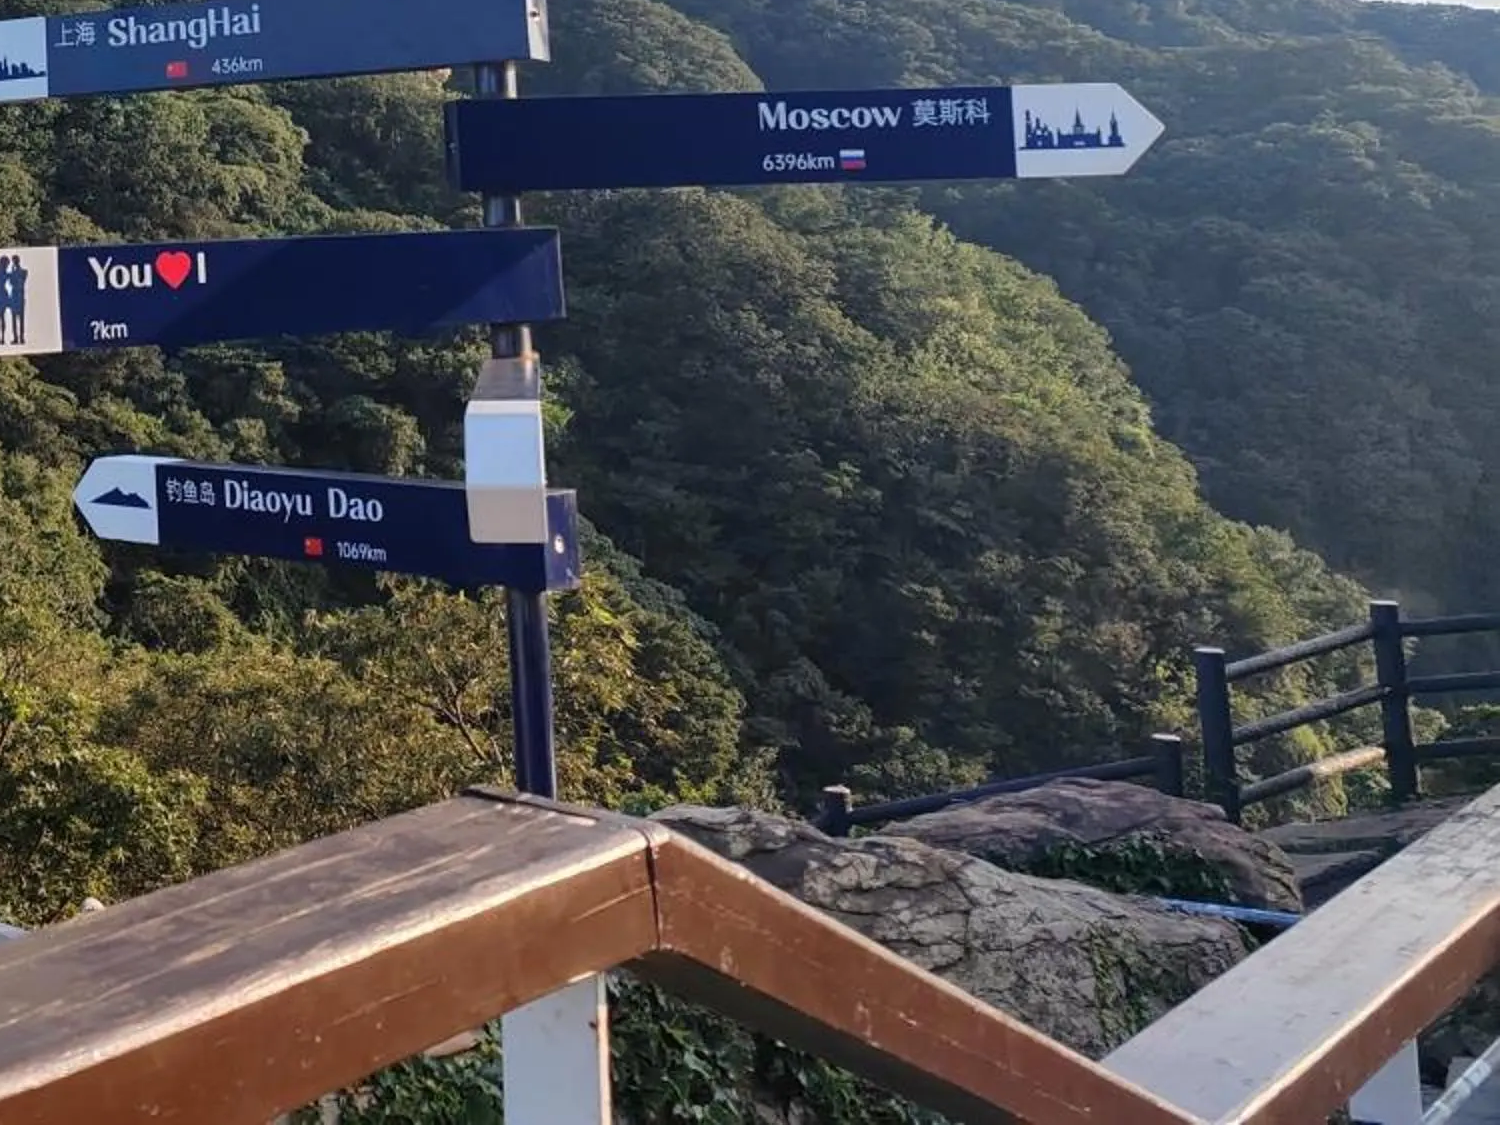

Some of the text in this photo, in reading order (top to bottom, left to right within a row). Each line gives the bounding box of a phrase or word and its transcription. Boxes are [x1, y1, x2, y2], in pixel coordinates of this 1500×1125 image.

[54, 4, 261, 49] 上海 ShangHai
[211, 56, 263, 75] 436km
[758, 97, 991, 131] Moscow 莫斯科
[763, 152, 835, 172] 6396km
[88, 252, 207, 290] You I
[165, 476, 383, 523] 钓鱼岛 Diaoyu Dao
[336, 540, 387, 562] 1069km
